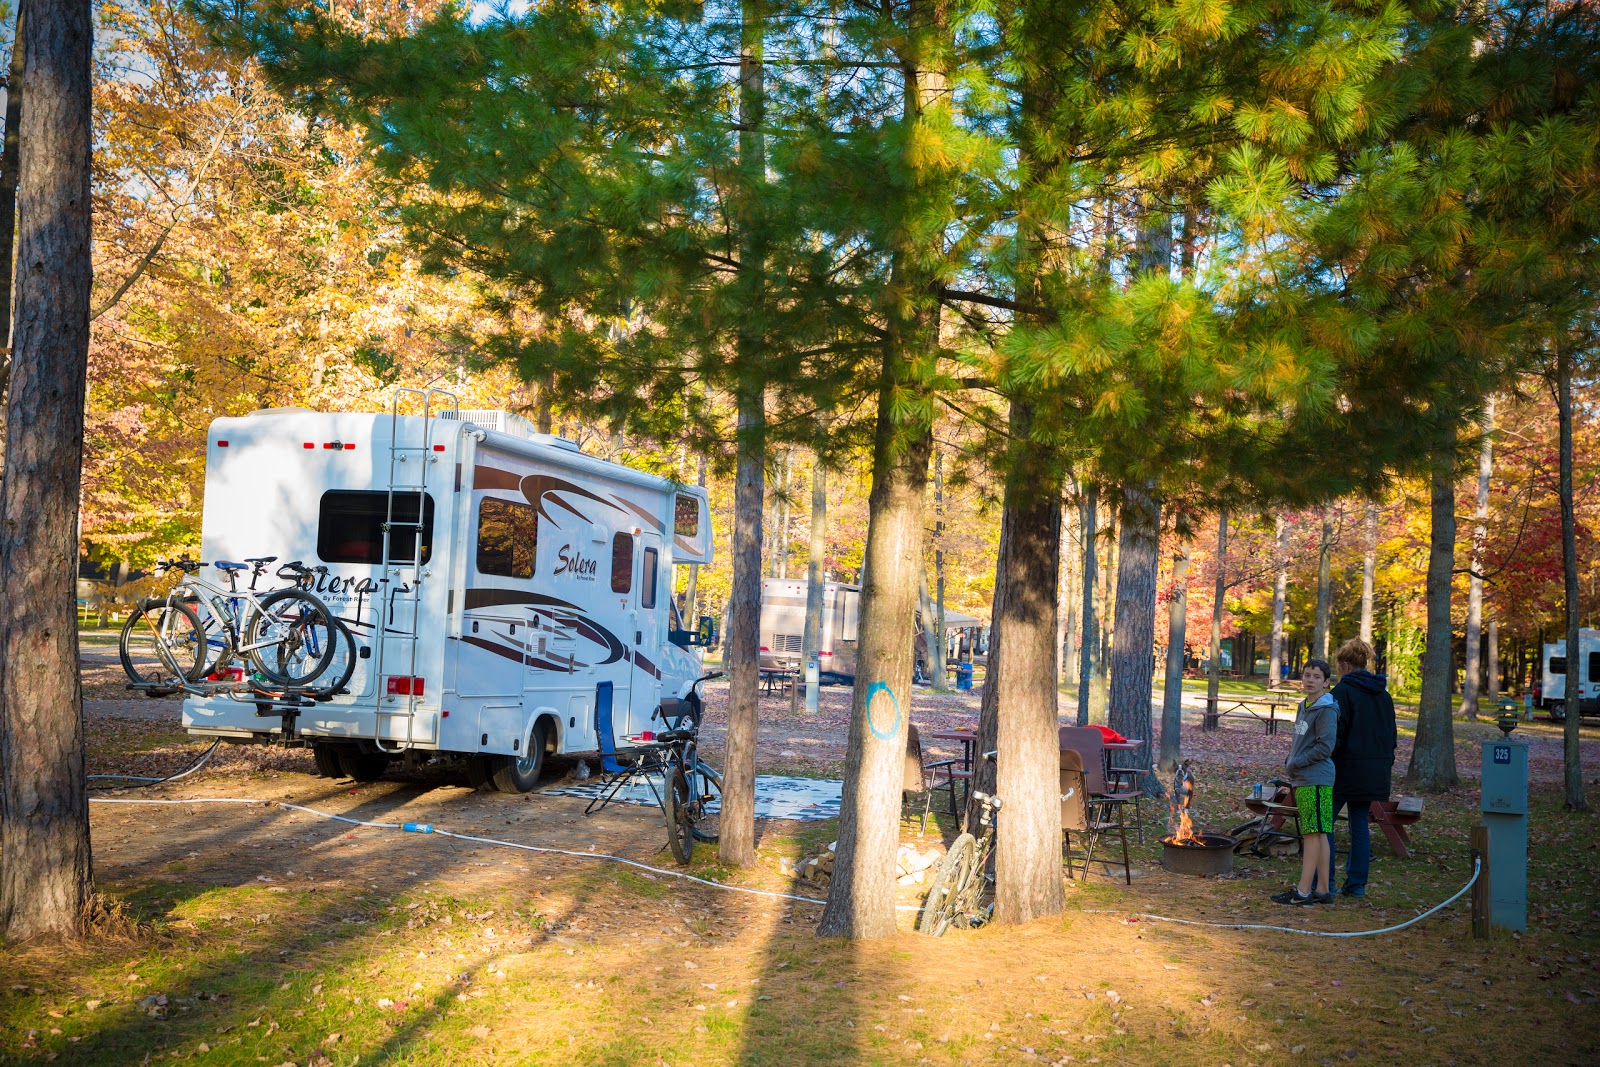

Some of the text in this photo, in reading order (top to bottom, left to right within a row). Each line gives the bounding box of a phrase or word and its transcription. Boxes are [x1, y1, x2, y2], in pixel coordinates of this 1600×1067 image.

[553, 544, 597, 576] Solera
[269, 561, 373, 595] Solera
[1495, 748, 1509, 760] 325
